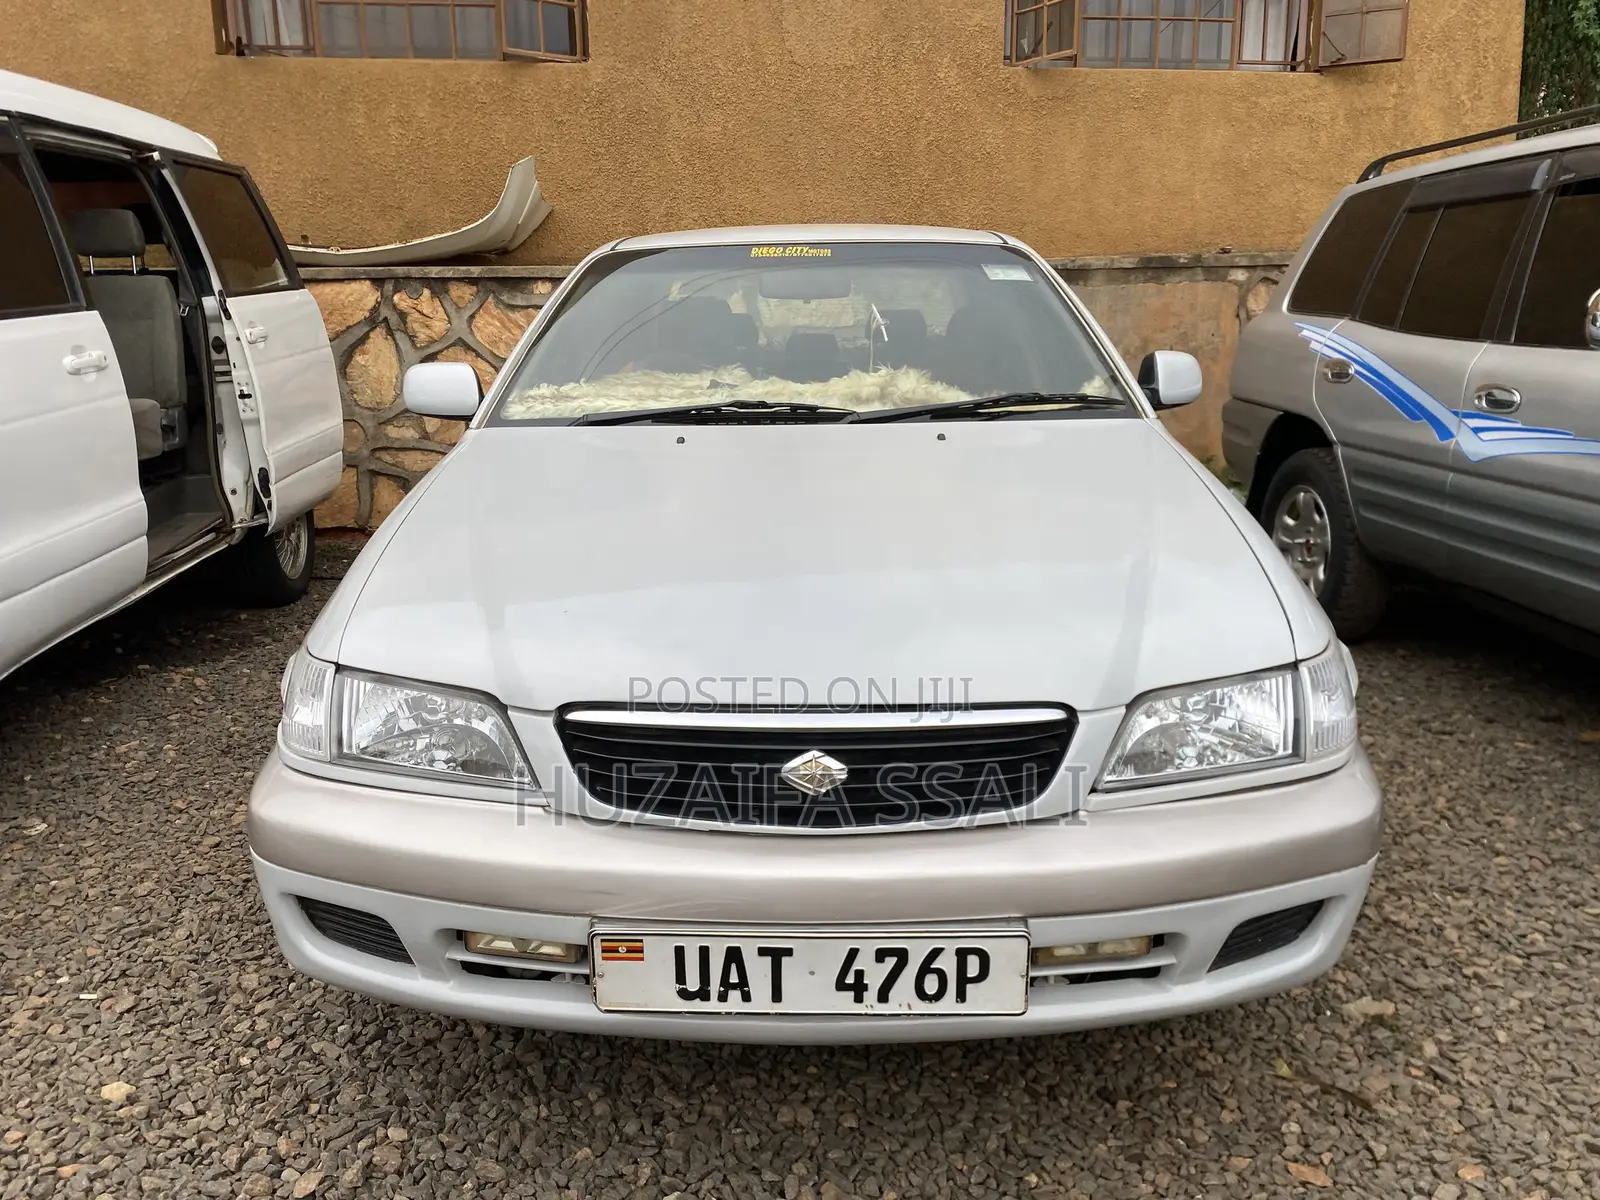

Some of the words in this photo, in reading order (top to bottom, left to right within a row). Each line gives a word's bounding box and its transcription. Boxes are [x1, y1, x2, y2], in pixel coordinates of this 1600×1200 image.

[785, 246, 809, 254] CITY
[673, 944, 793, 1002] UAT
[835, 946, 991, 1003] 476P
